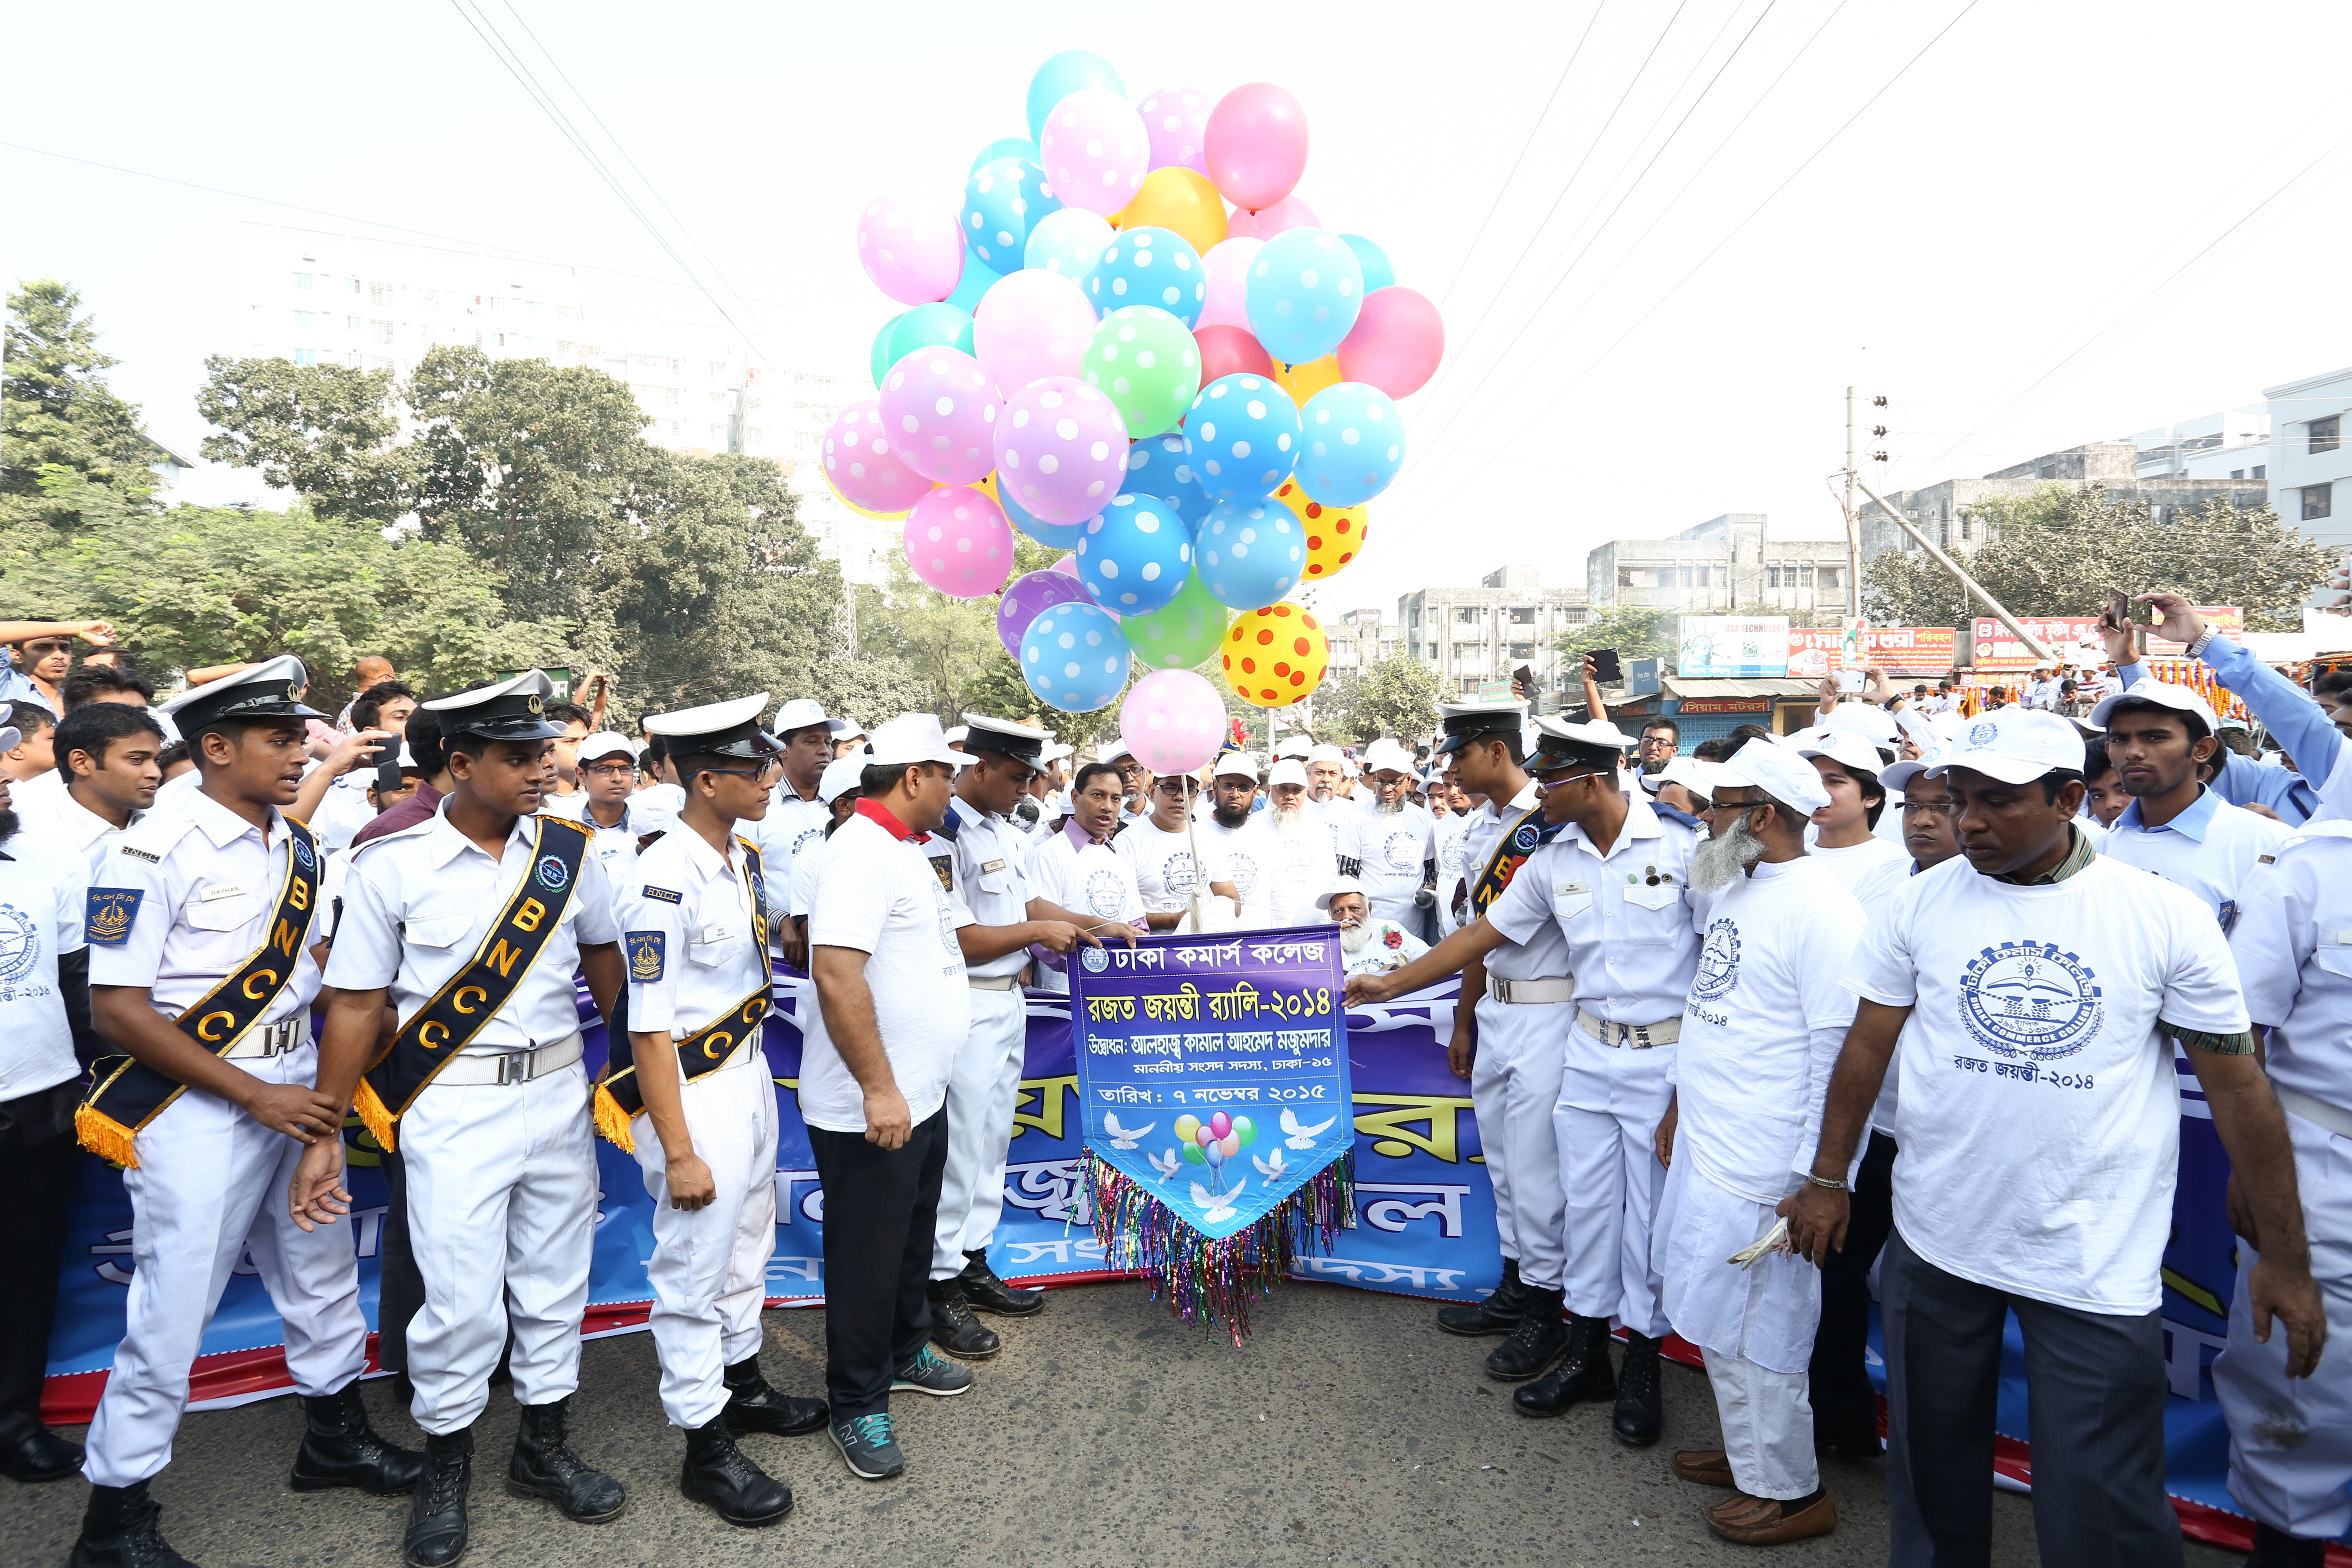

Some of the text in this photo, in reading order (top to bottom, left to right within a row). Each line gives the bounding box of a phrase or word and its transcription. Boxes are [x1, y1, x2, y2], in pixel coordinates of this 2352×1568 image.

[1742, 624, 1786, 633] TECHNOLOGY
[1915, 630, 1952, 643] পরিবহন
[1684, 666, 1707, 675] সিয়াম
[1685, 701, 1766, 713] সিয়াম মটরস
[122, 846, 158, 862] BNCC
[211, 886, 239, 895] RAYHAN
[646, 887, 679, 902] BNCC
[1111, 939, 1326, 971] ঢাকা কমার্স কলেজ
[942, 965, 957, 977] রজত
[1713, 965, 1734, 988] COLLEGE
[1085, 995, 1136, 1023] রজত
[1141, 982, 1201, 1023] জয়ন্তী
[1969, 996, 2093, 1043] DHAKA COMMERCE COLLEGE
[1088, 1029, 1332, 1060] উদ্বোধন: আলহাজ্ব কামাল আহমেদ মজুমদার
[1133, 1059, 1184, 1074] মাননীয়
[1187, 1062, 1224, 1073] সংসদ
[1271, 1056, 1332, 1071] ঢাকা-১৫
[1953, 1055, 2094, 1089] রজত জয়ন্তী-২০১৪
[1173, 1090, 1186, 1104] ৭
[1192, 1087, 1260, 1103] নভেম্বর
[1268, 1084, 1328, 1103] ২০১৫
